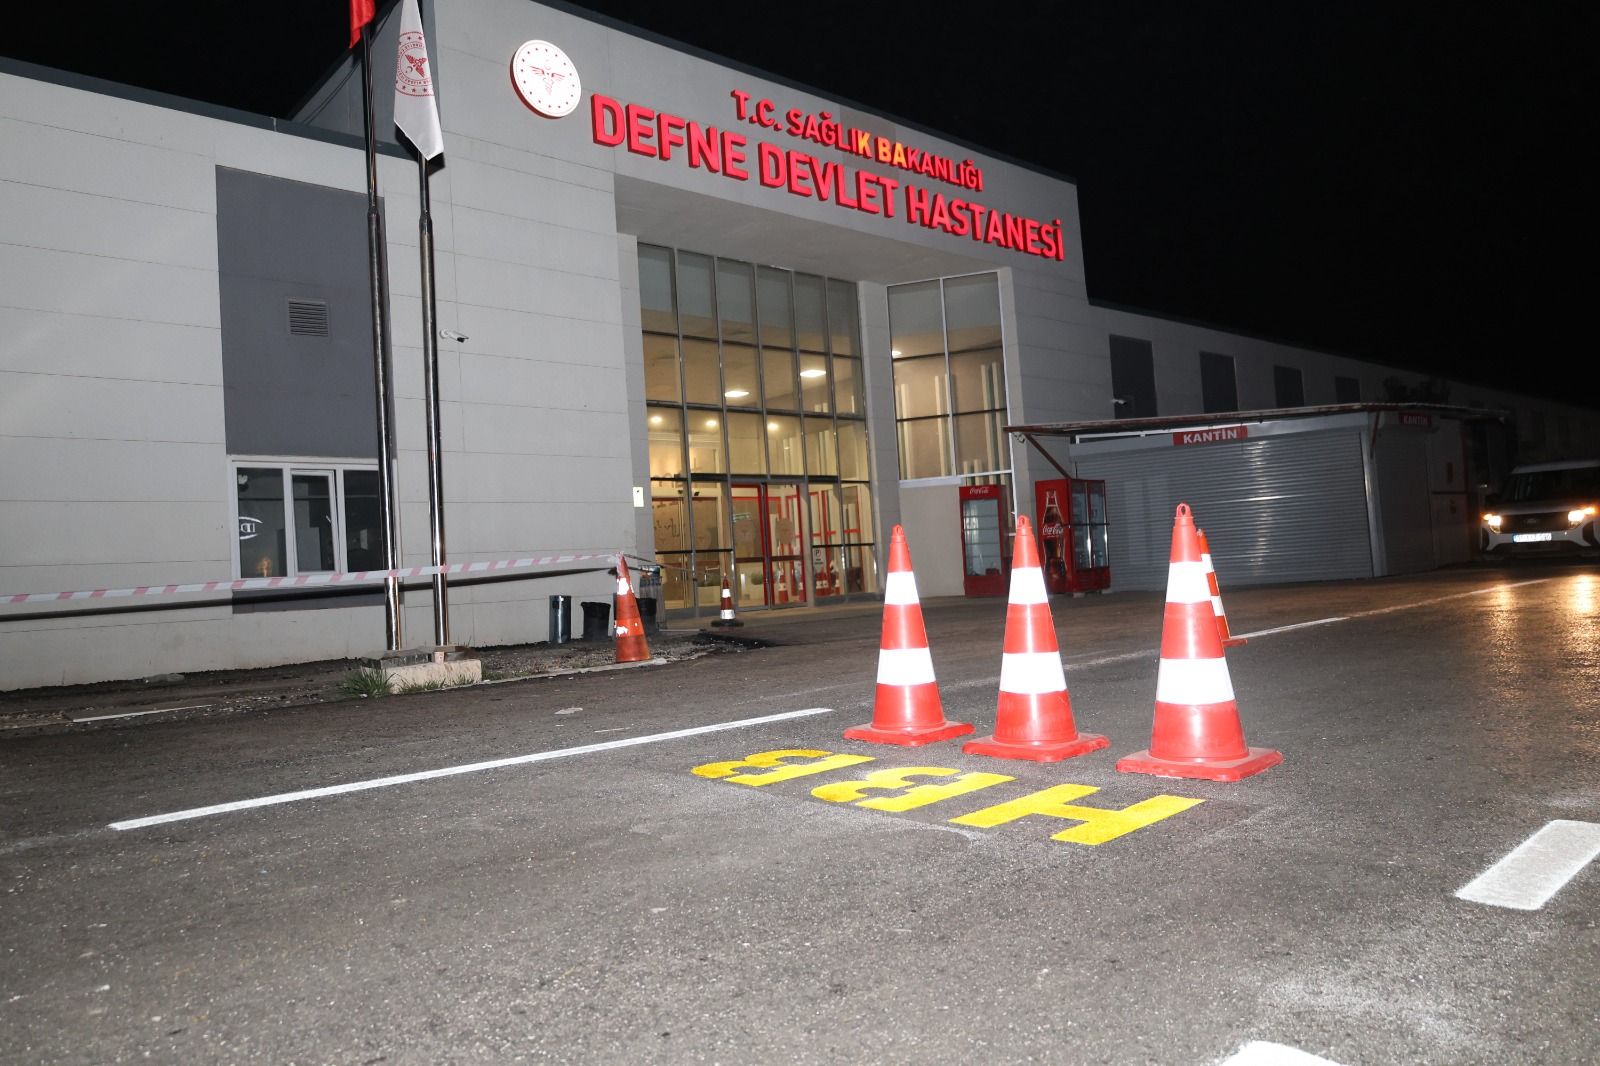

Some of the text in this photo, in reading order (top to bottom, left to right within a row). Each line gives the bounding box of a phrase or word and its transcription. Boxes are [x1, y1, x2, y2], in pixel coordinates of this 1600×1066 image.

[591, 92, 1066, 262] DEFNE DEVLET HASTANESİ
[731, 89, 985, 193] T.C. SAĞLIK BAKANLIĞI
[1183, 428, 1237, 444] KANTİN
